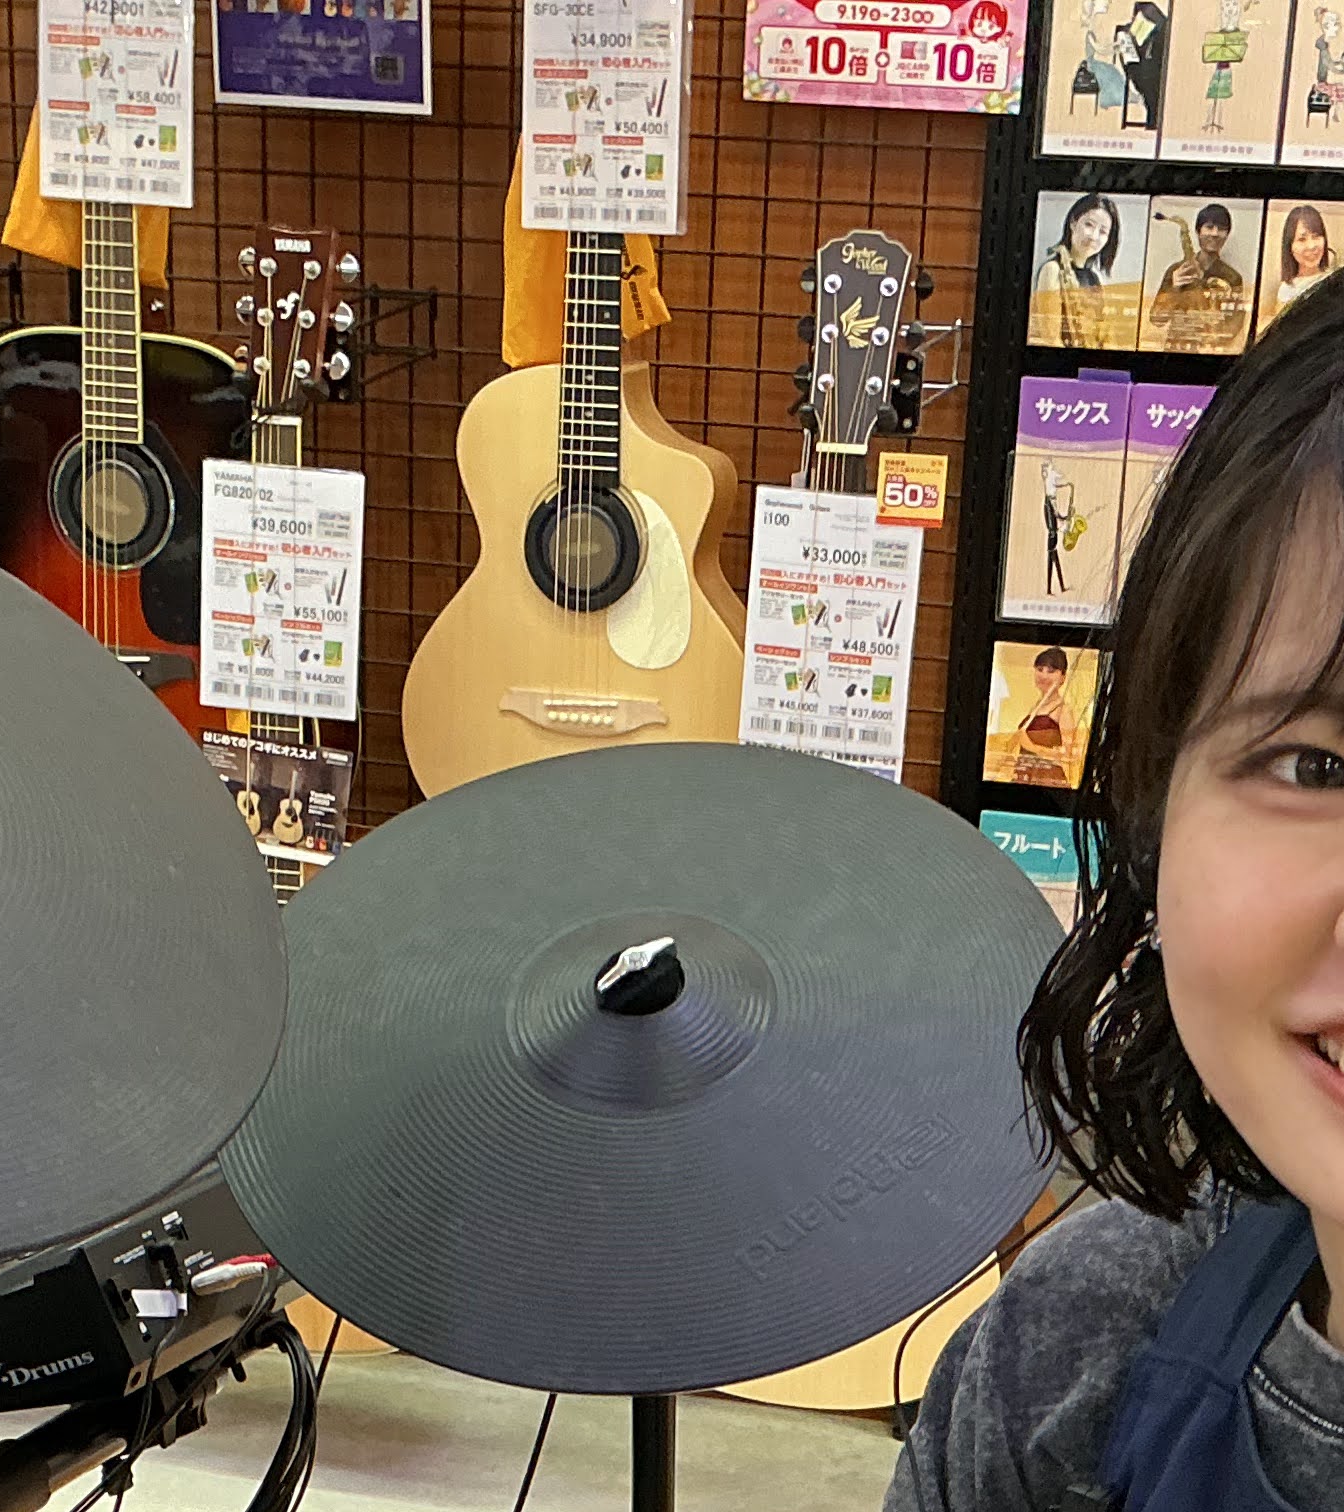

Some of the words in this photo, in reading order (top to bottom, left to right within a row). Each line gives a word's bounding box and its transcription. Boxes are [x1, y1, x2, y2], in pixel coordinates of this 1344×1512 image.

[1035, 397, 1111, 425] サックス
[251, 516, 306, 536] ¥39,600
[763, 513, 790, 527] i100
[801, 545, 861, 566] ¥33,000
[293, 604, 341, 623] ¥55,100
[841, 638, 894, 656] ¥48,500
[993, 831, 1067, 860] フルート
